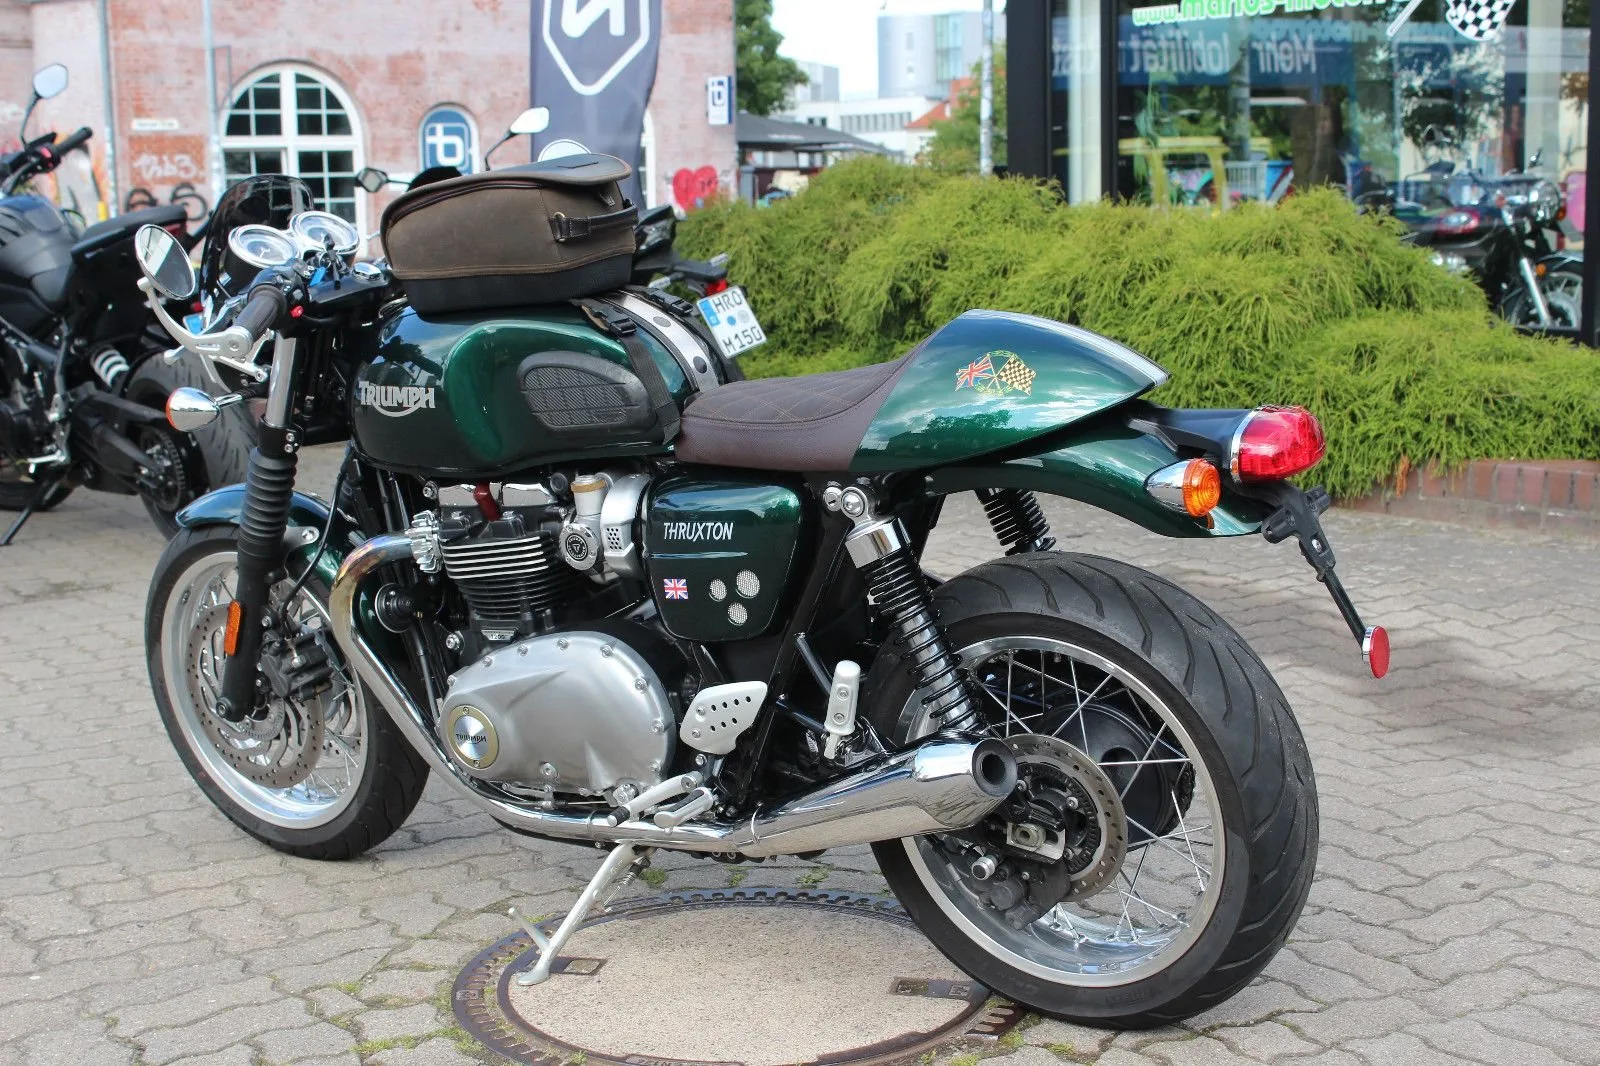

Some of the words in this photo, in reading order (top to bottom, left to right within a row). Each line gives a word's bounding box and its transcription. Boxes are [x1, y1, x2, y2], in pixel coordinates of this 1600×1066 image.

[712, 290, 743, 313] HRO
[358, 380, 436, 417] TRIUMPH
[663, 521, 734, 542] THRUXTON
[455, 733, 487, 744] TRIUMPH
